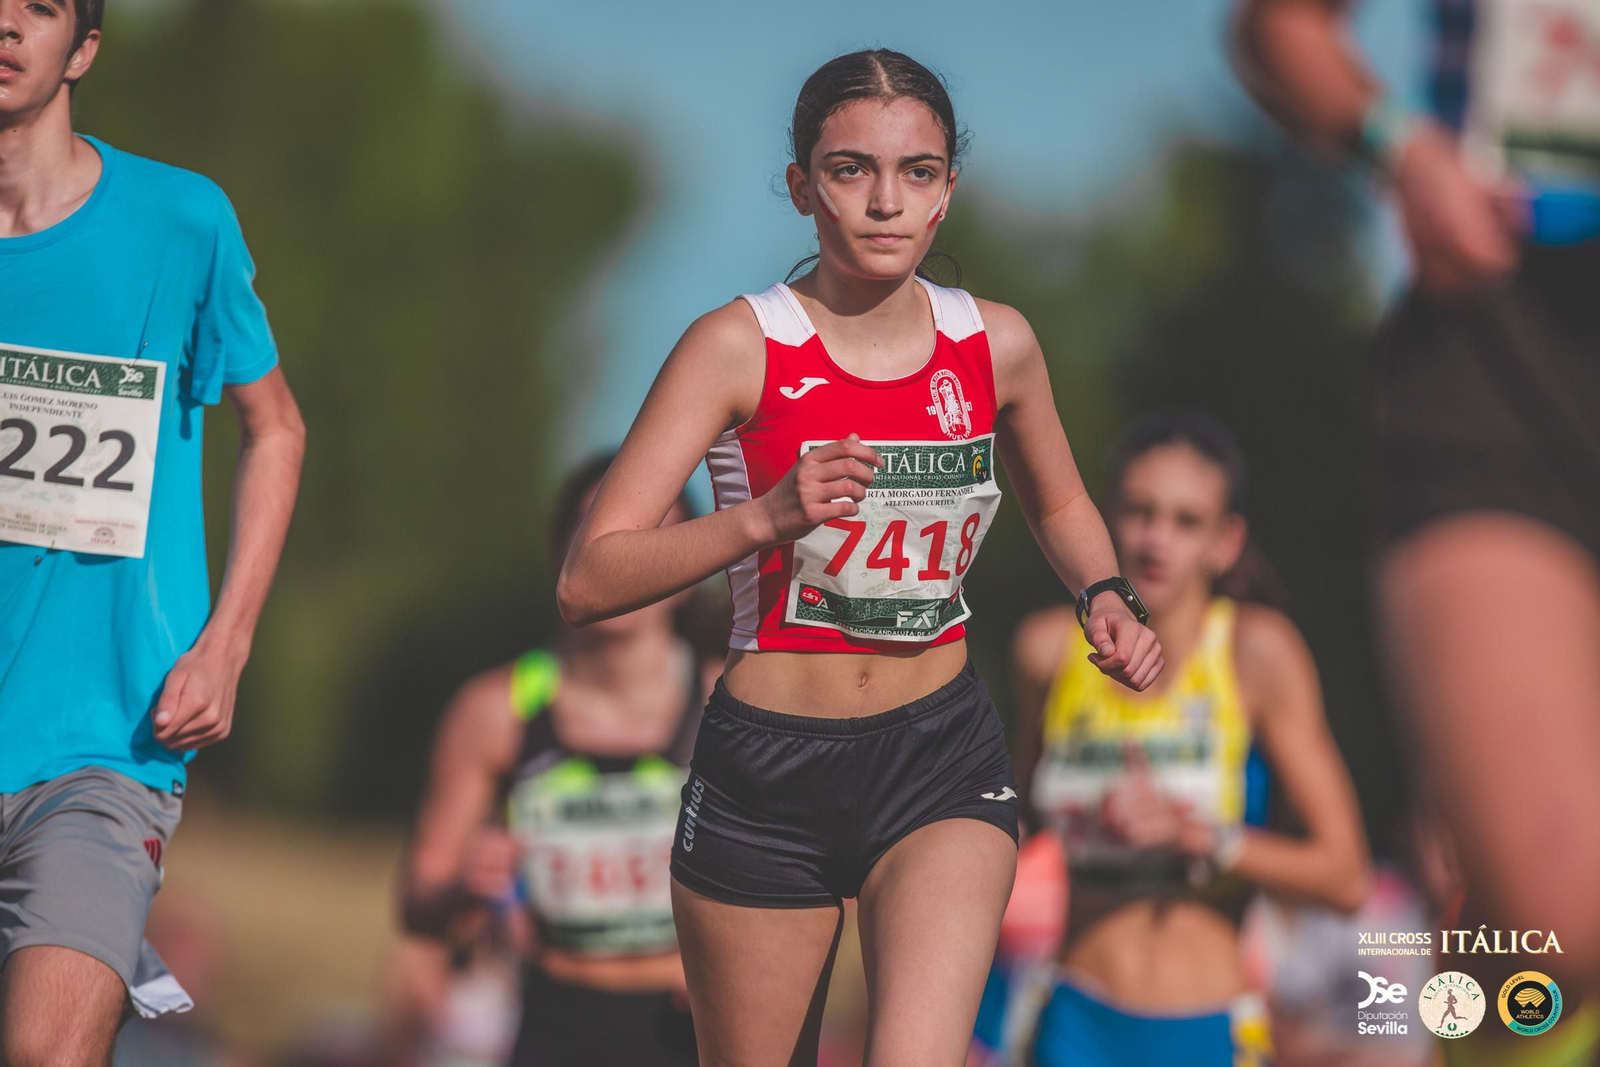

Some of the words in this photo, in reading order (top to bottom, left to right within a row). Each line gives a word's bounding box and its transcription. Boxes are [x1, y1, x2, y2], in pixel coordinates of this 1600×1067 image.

[0, 355, 101, 389] ITÁLICA
[20, 393, 55, 405] GOMEZ
[57, 398, 99, 410] MORENO
[9, 402, 84, 419] INDEPENDIENTE
[946, 429, 971, 440] HUELVA
[0, 418, 136, 491] 222
[865, 490, 885, 498] RTA
[887, 490, 933, 498] MORGADO
[823, 512, 981, 581] 7418
